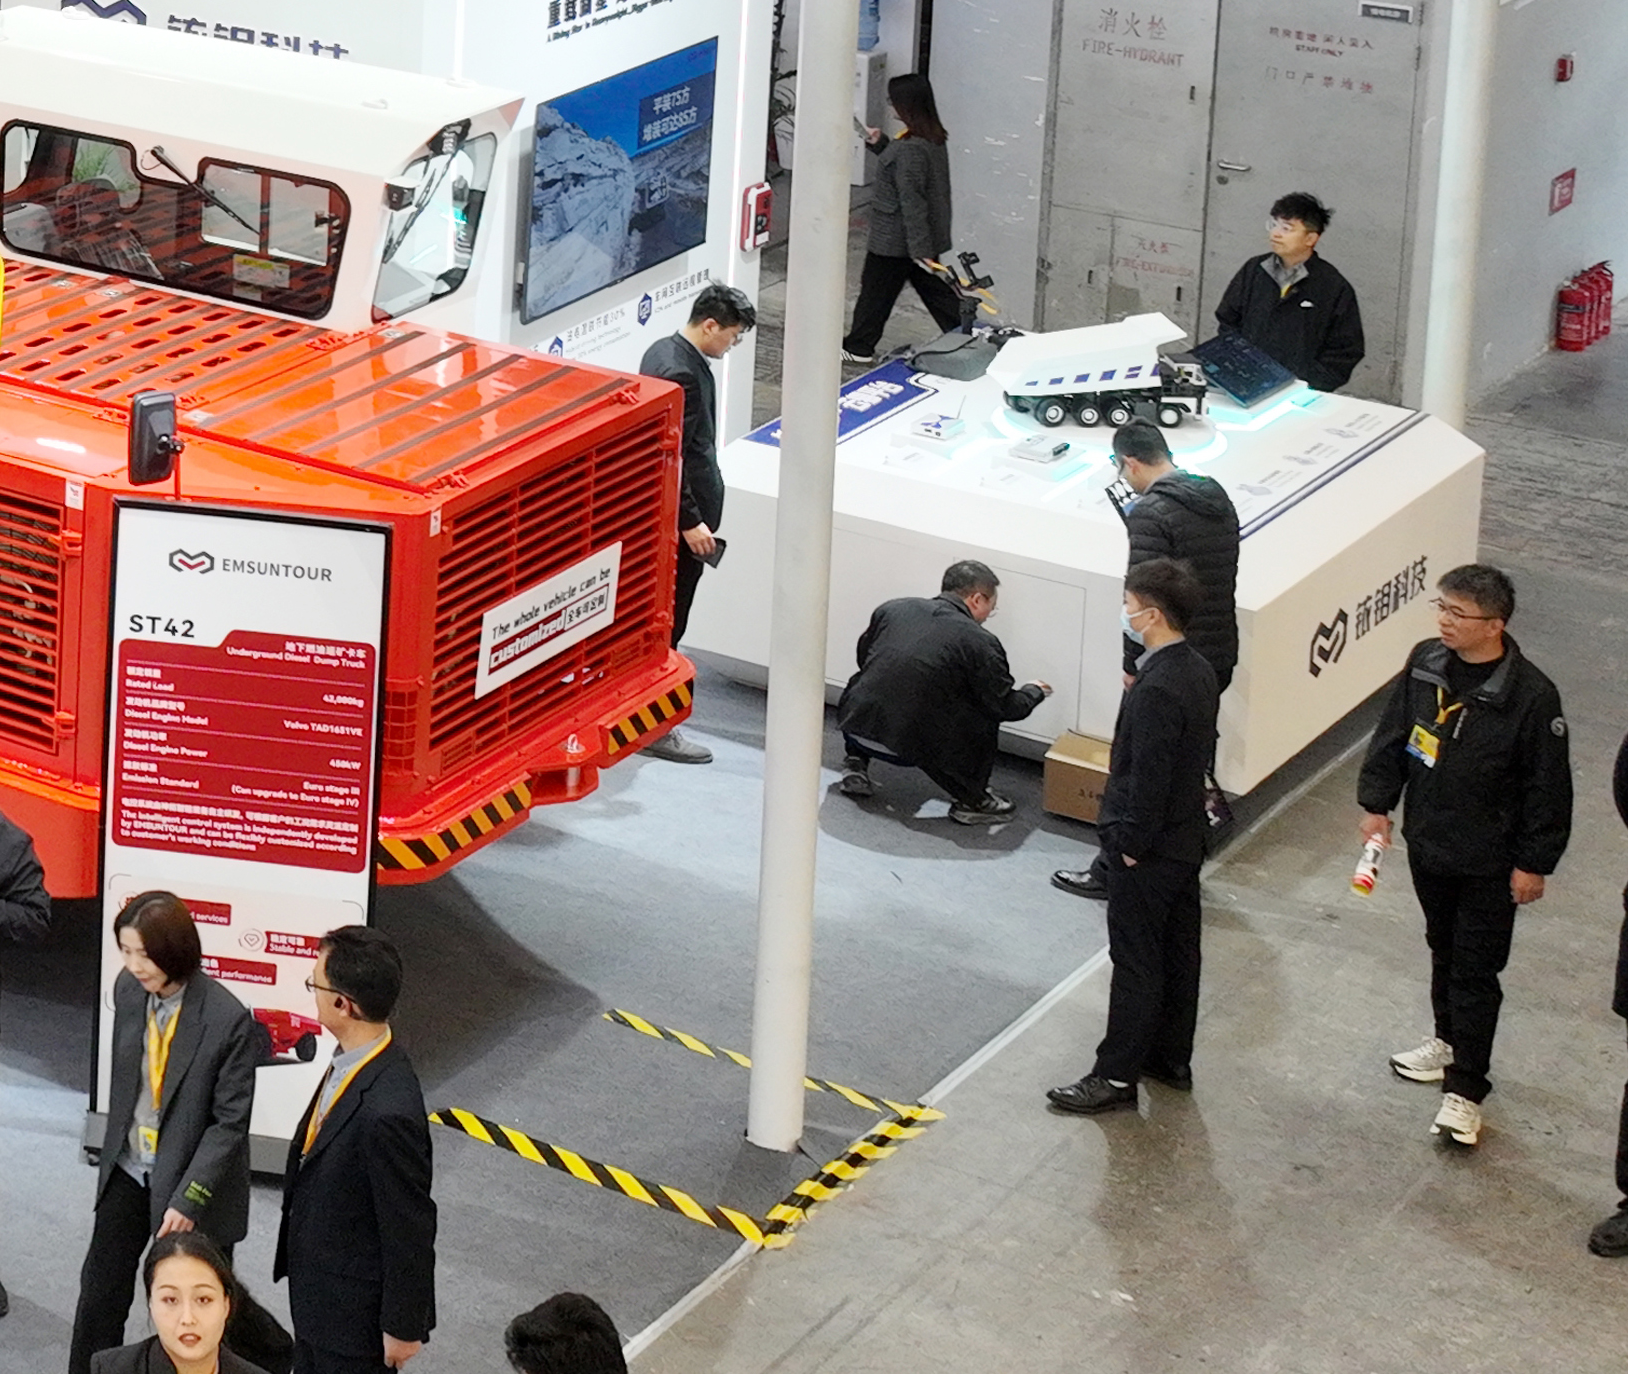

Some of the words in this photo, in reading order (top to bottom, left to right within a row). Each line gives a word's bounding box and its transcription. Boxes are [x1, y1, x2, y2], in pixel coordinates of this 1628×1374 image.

[1098, 7, 1168, 41] 消火栓
[1081, 37, 1185, 67] FIRE-HYDRANT
[221, 557, 333, 583] EMSUNTOUR
[491, 620, 511, 641] The
[513, 604, 541, 629] whole
[542, 584, 578, 613] vehicle
[579, 574, 597, 594] can
[599, 566, 612, 582] be
[128, 613, 196, 639] ST42
[226, 645, 283, 662] Underground
[284, 650, 311, 664] Diesel
[313, 653, 339, 669] Dump
[340, 657, 366, 670] Truck
[125, 677, 152, 691] Rated
[152, 680, 175, 692] Load
[124, 708, 150, 721] Diesel
[151, 710, 181, 725] Engine
[181, 713, 209, 727] Model
[123, 739, 149, 753] Diesel
[150, 742, 180, 756] Engine
[180, 745, 209, 759] Power
[121, 771, 159, 786] Emission
[159, 775, 200, 790] Standard
[324, 784, 350, 797] stage
[252, 787, 288, 802] upgrade
[320, 796, 345, 808] stage
[121, 810, 137, 821] The
[137, 811, 181, 825] intelligent
[181, 815, 213, 827] control
[213, 819, 243, 832] system
[252, 824, 313, 841] independently
[313, 830, 359, 846] developed
[133, 820, 188, 835] EMSUNTOUR
[188, 826, 206, 837] and
[206, 828, 221, 838] can
[221, 828, 234, 839] be
[234, 829, 266, 844] flexibly
[315, 840, 358, 856] according
[176, 833, 212, 848] working
[212, 837, 257, 852] conditions
[194, 909, 229, 926] services
[268, 942, 291, 955] Stable
[291, 946, 311, 957] and
